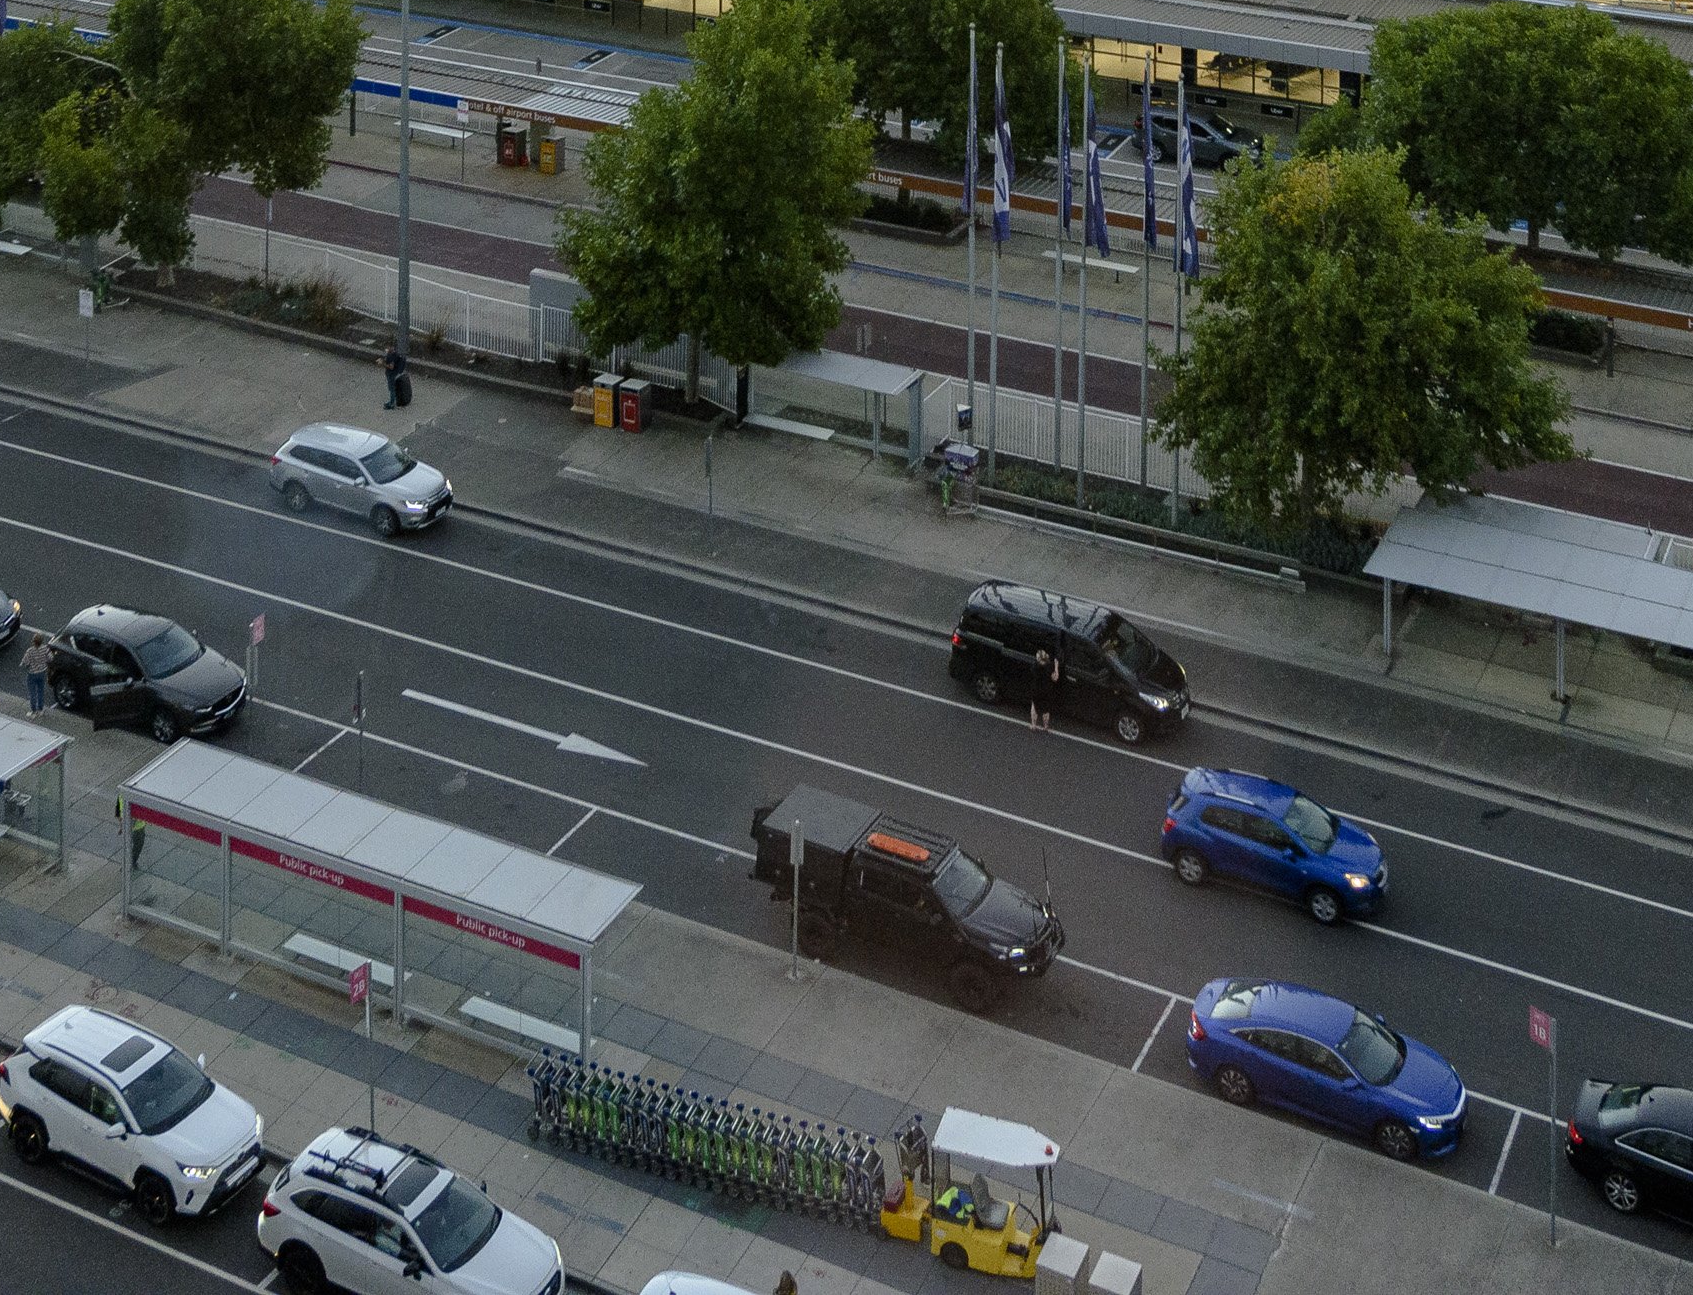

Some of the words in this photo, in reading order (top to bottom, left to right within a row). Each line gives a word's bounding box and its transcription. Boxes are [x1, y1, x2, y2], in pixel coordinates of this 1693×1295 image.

[493, 104, 506, 115] off
[506, 108, 533, 121] airport
[534, 111, 556, 124] buses
[878, 172, 903, 185] buses
[279, 855, 307, 874] Public
[309, 863, 344, 886] pick-up
[457, 913, 486, 936] Public
[488, 923, 526, 949] pick-up
[353, 979, 365, 998] 2B
[1533, 1023, 1546, 1041] 1B
